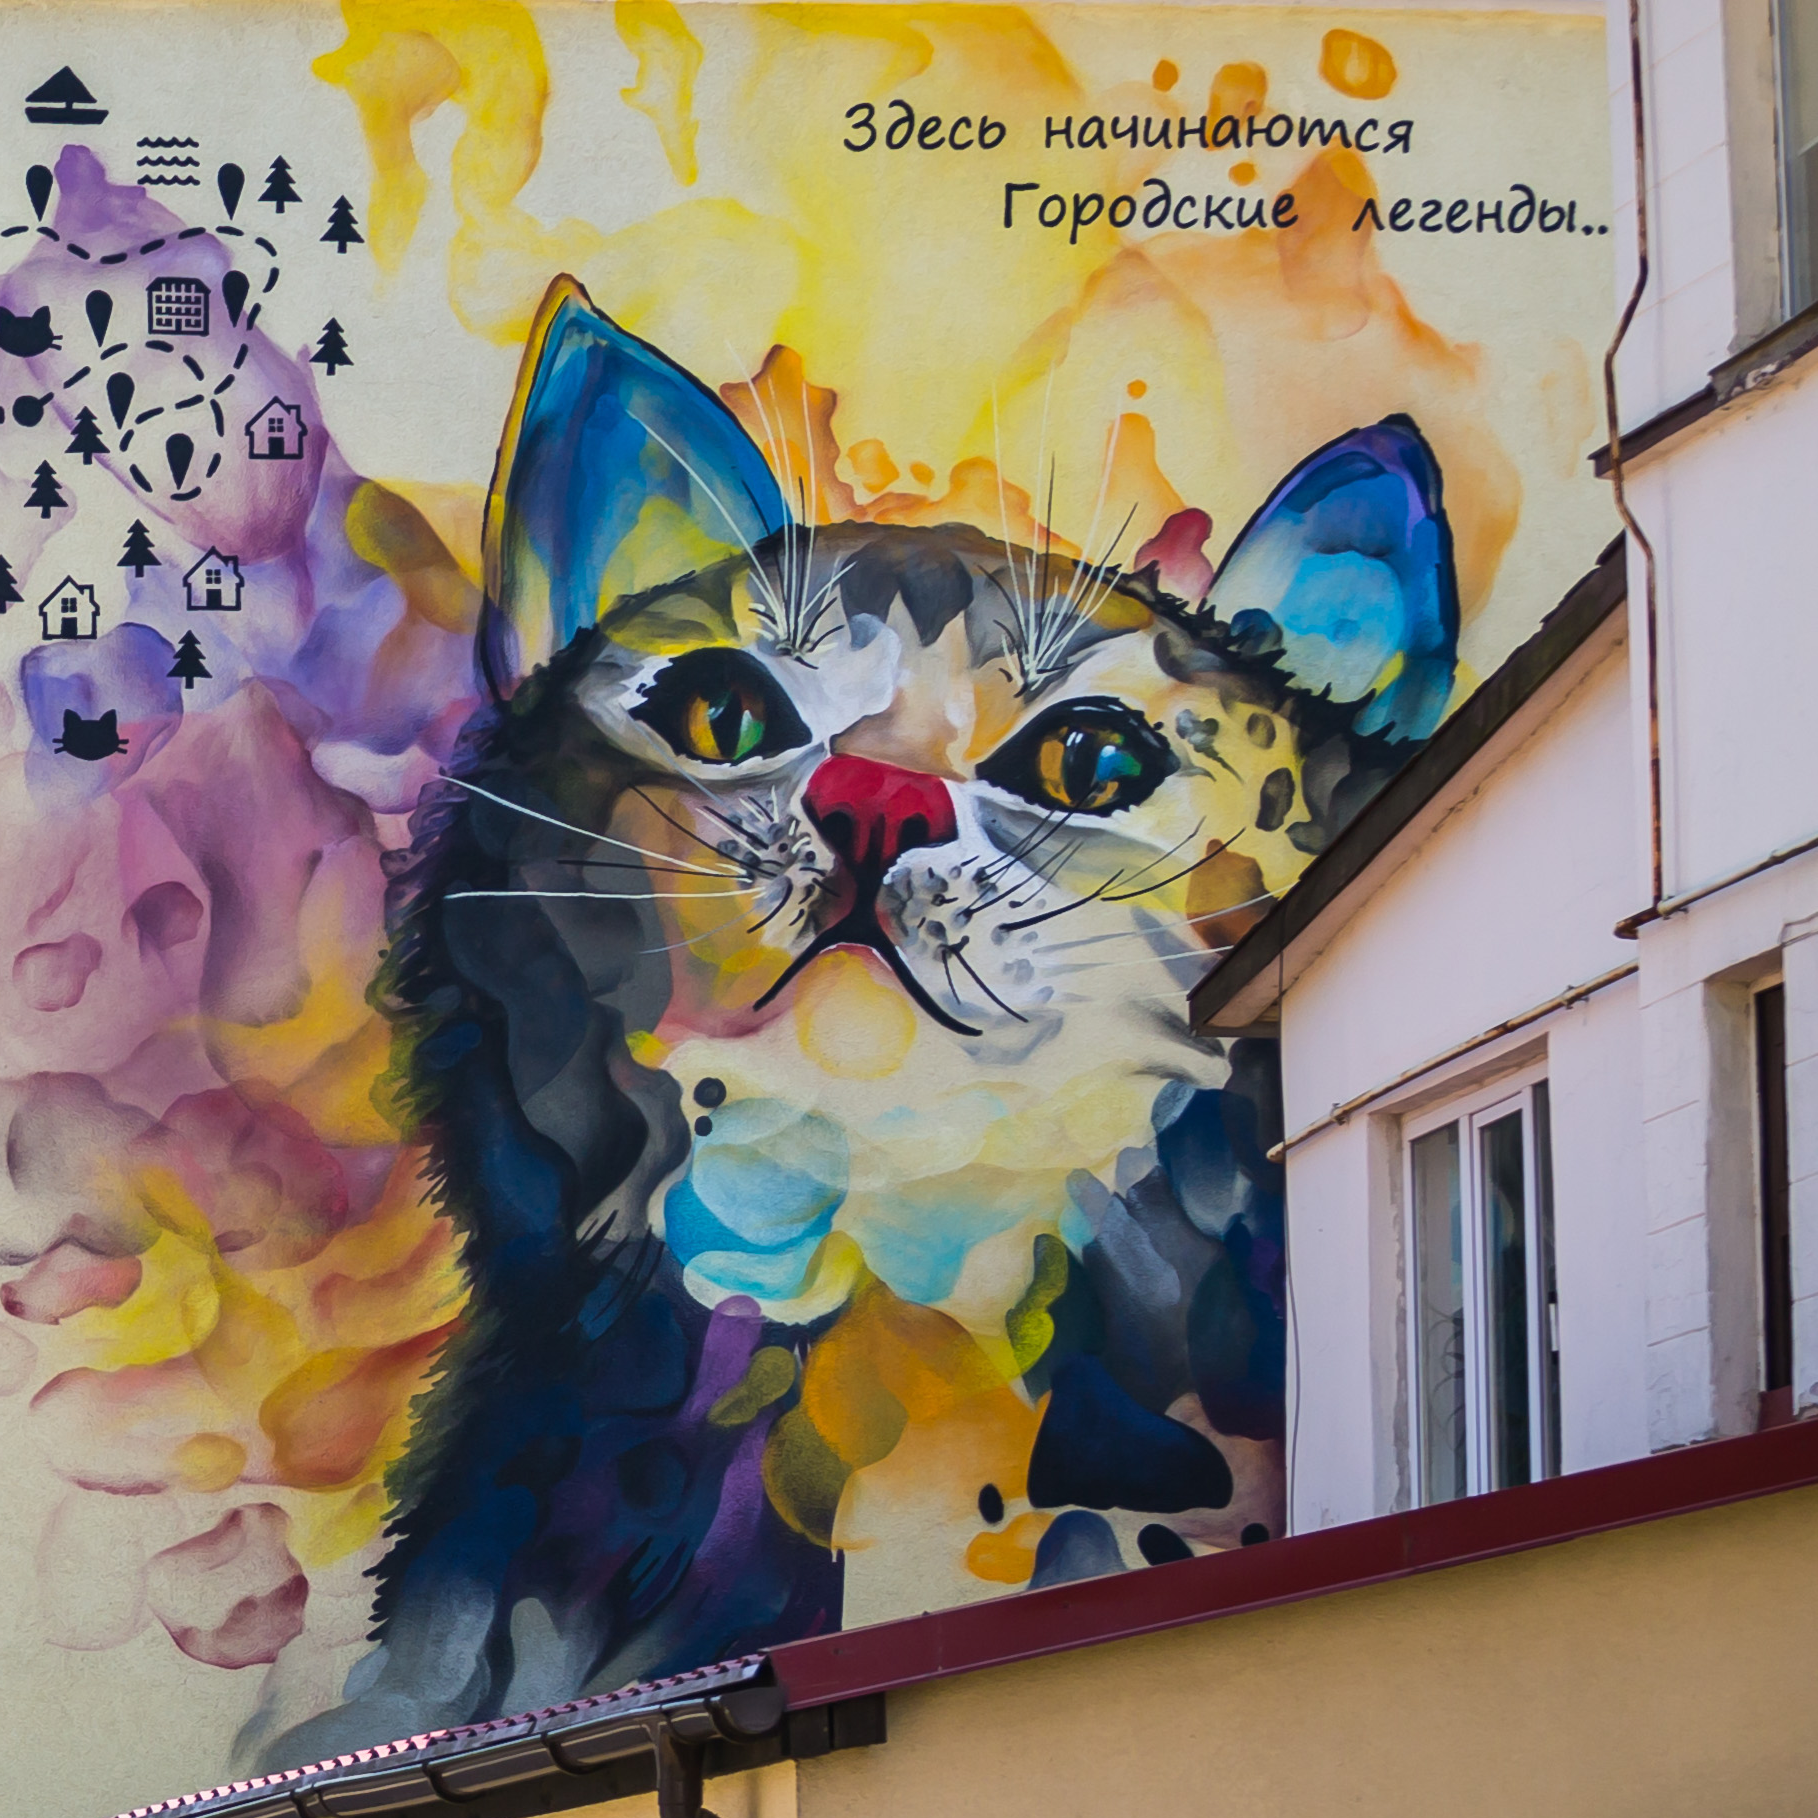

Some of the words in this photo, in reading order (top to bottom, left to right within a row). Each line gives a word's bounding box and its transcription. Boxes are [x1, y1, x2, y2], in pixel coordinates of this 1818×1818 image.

[841, 101, 1008, 154] Здесь
[1044, 111, 1415, 154] начинаются
[1003, 178, 1300, 244] Городские
